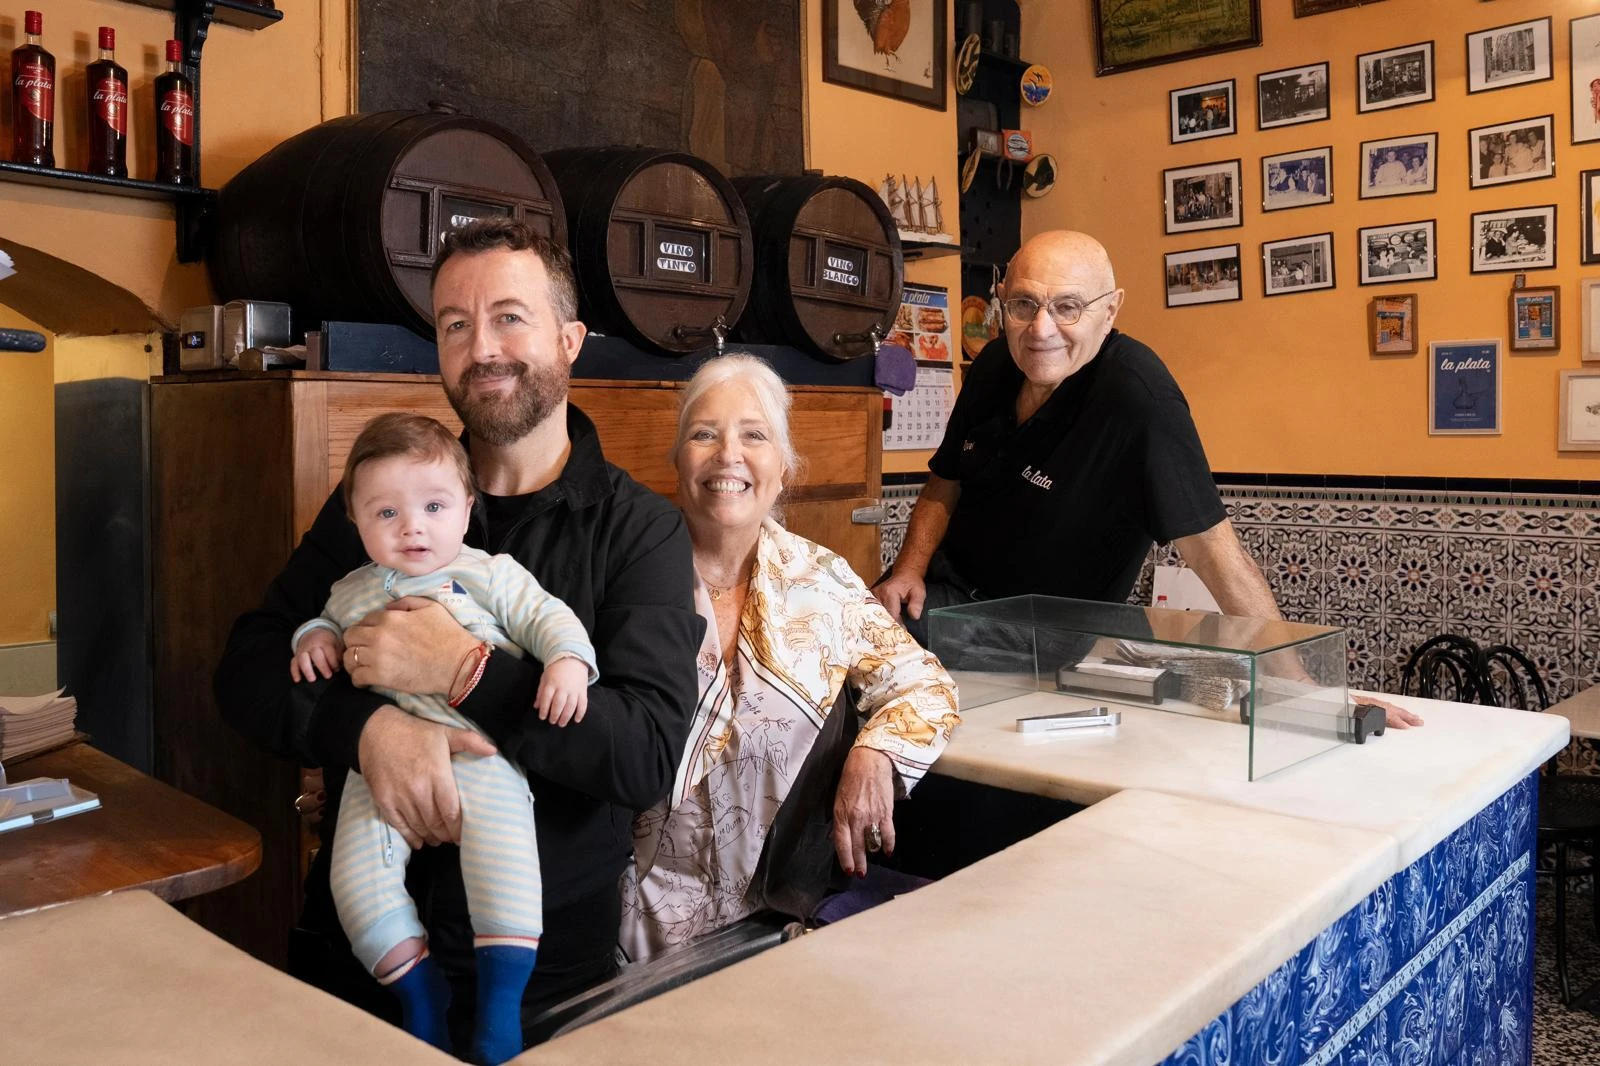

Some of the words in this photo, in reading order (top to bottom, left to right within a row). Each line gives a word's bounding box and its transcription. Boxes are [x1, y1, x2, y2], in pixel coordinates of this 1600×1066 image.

[15, 76, 24, 86] la
[25, 77, 52, 89] plata
[93, 90, 103, 100] la
[161, 101, 171, 111] la
[662, 242, 693, 257] VINO
[659, 258, 696, 273] TINTO
[829, 257, 854, 271] VINO
[823, 269, 859, 286] BLANCO
[908, 291, 931, 304] plata
[1440, 358, 1455, 371] la
[1454, 357, 1491, 374] plata
[1021, 465, 1032, 480] la
[753, 691, 765, 702] la
